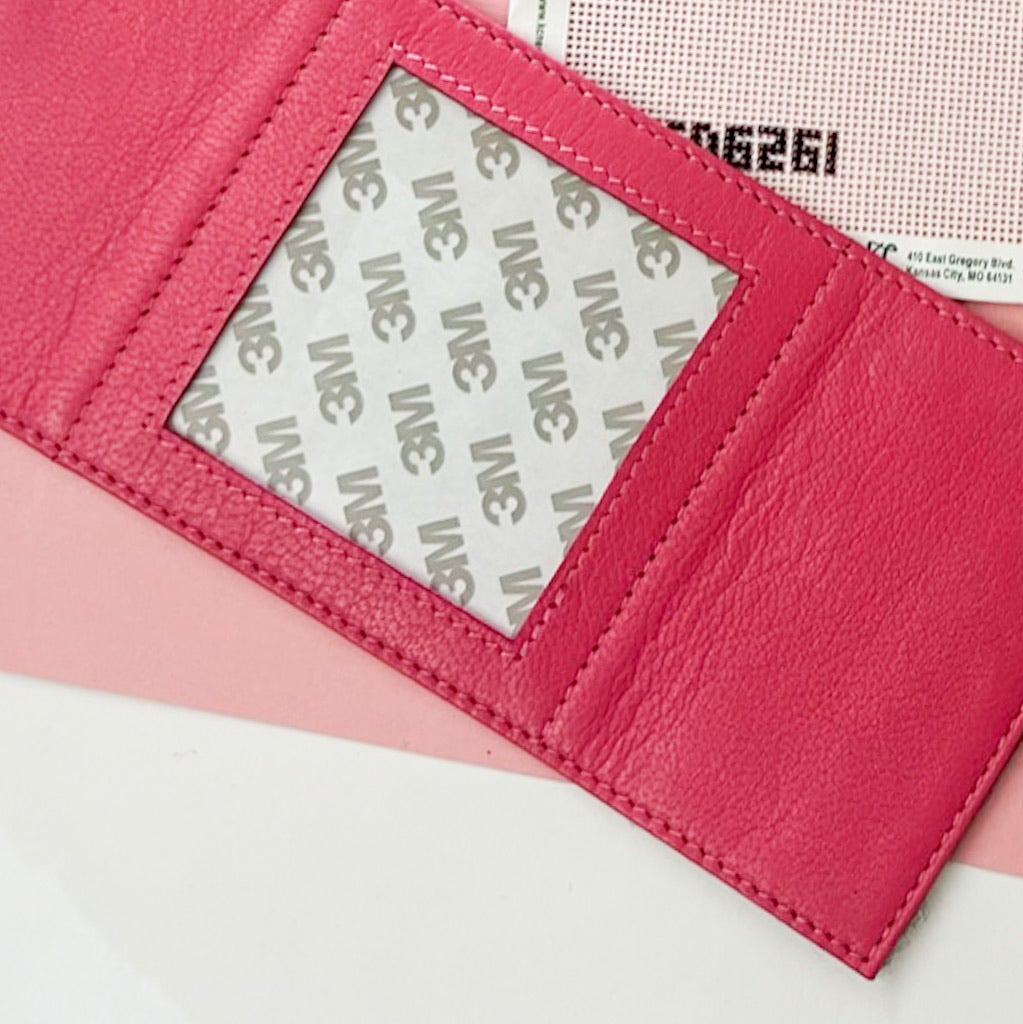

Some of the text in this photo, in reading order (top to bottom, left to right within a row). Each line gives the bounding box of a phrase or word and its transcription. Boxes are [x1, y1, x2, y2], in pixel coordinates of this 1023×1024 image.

[335, 120, 389, 213] 3M
[666, 120, 839, 176] D6261
[283, 203, 335, 294] 3M
[411, 170, 469, 263] 3M
[907, 251, 1013, 270] 410 East Gregory Blvd.
[359, 252, 417, 344] 3M
[491, 220, 550, 313] 3M
[943, 267, 965, 283] City,
[967, 269, 984, 282] MO
[232, 283, 283, 375] 3M
[439, 301, 497, 395] 3M
[572, 269, 630, 362] 3M
[305, 333, 365, 426] 3M
[519, 350, 579, 444] 3M
[255, 416, 313, 506] 3M
[387, 383, 446, 476] 3M
[336, 466, 394, 556] 3M
[469, 433, 527, 527] 3M
[417, 516, 476, 607] 3M
